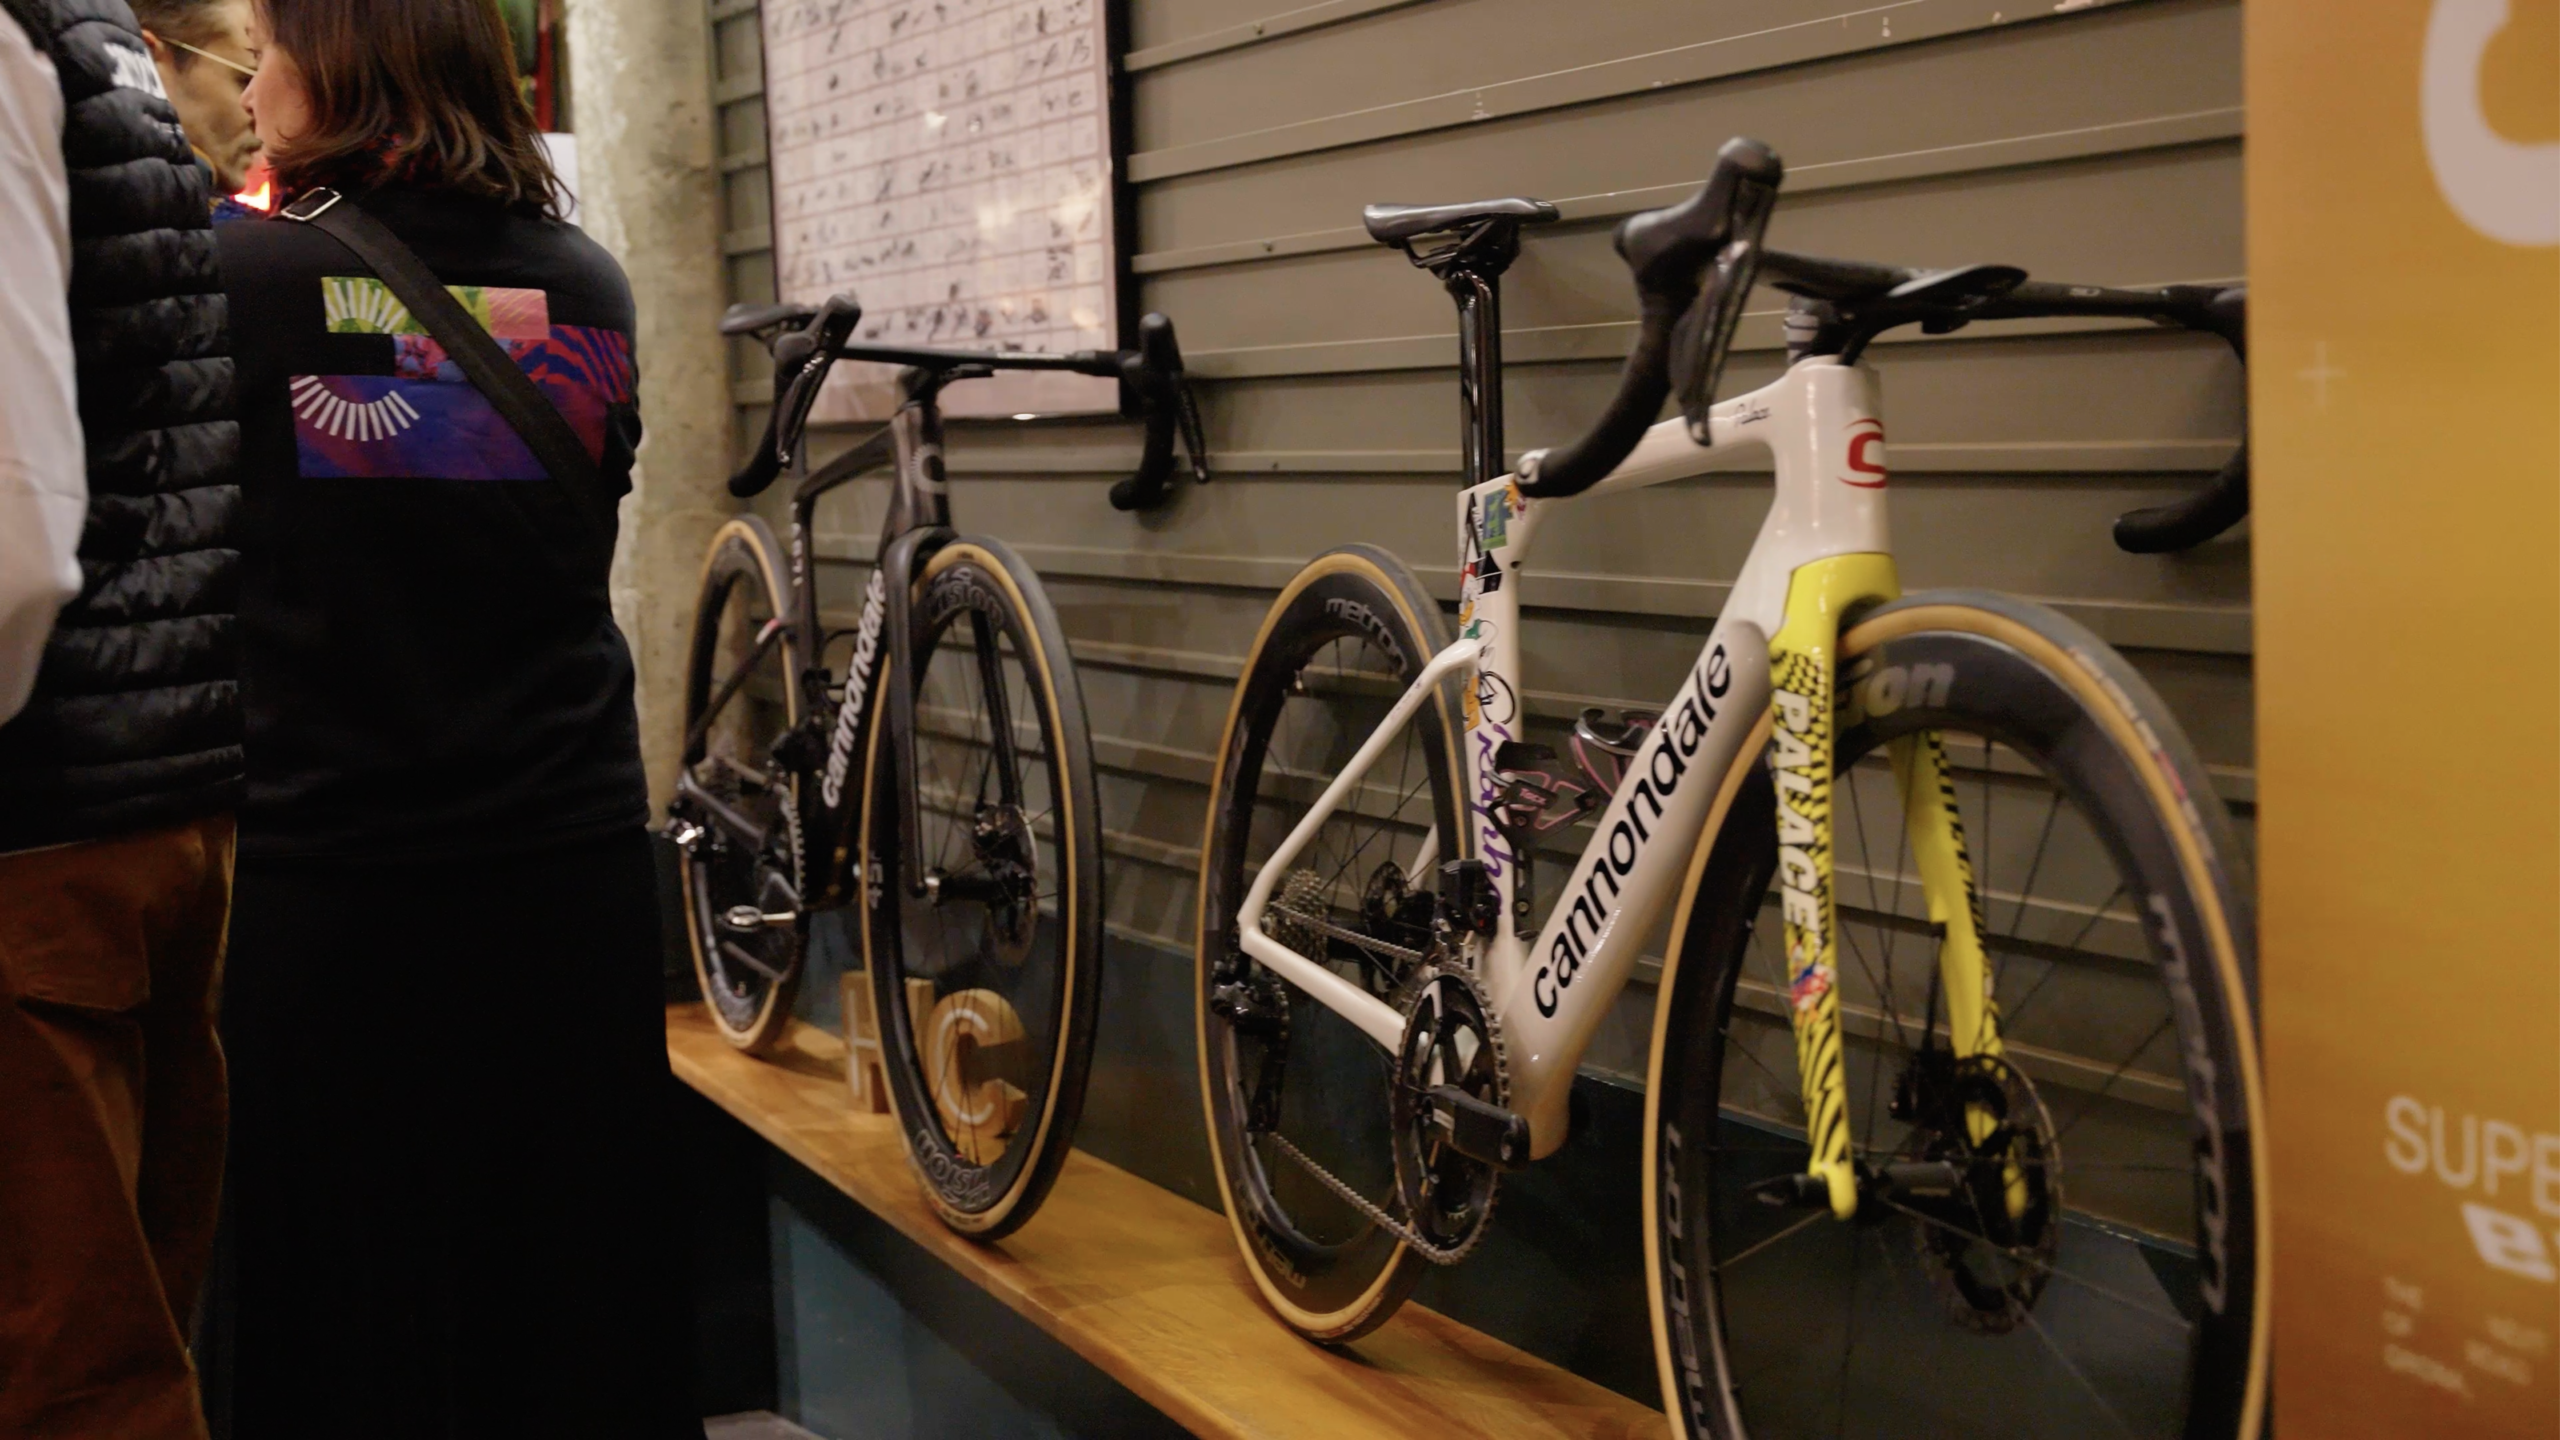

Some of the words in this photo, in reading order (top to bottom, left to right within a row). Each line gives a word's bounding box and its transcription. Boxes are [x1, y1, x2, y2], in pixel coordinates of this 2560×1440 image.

[822, 568, 887, 809] cannondale
[1326, 598, 1408, 677] metron
[1533, 643, 1732, 1019] cannondale
[1774, 687, 1820, 932] PALACE
